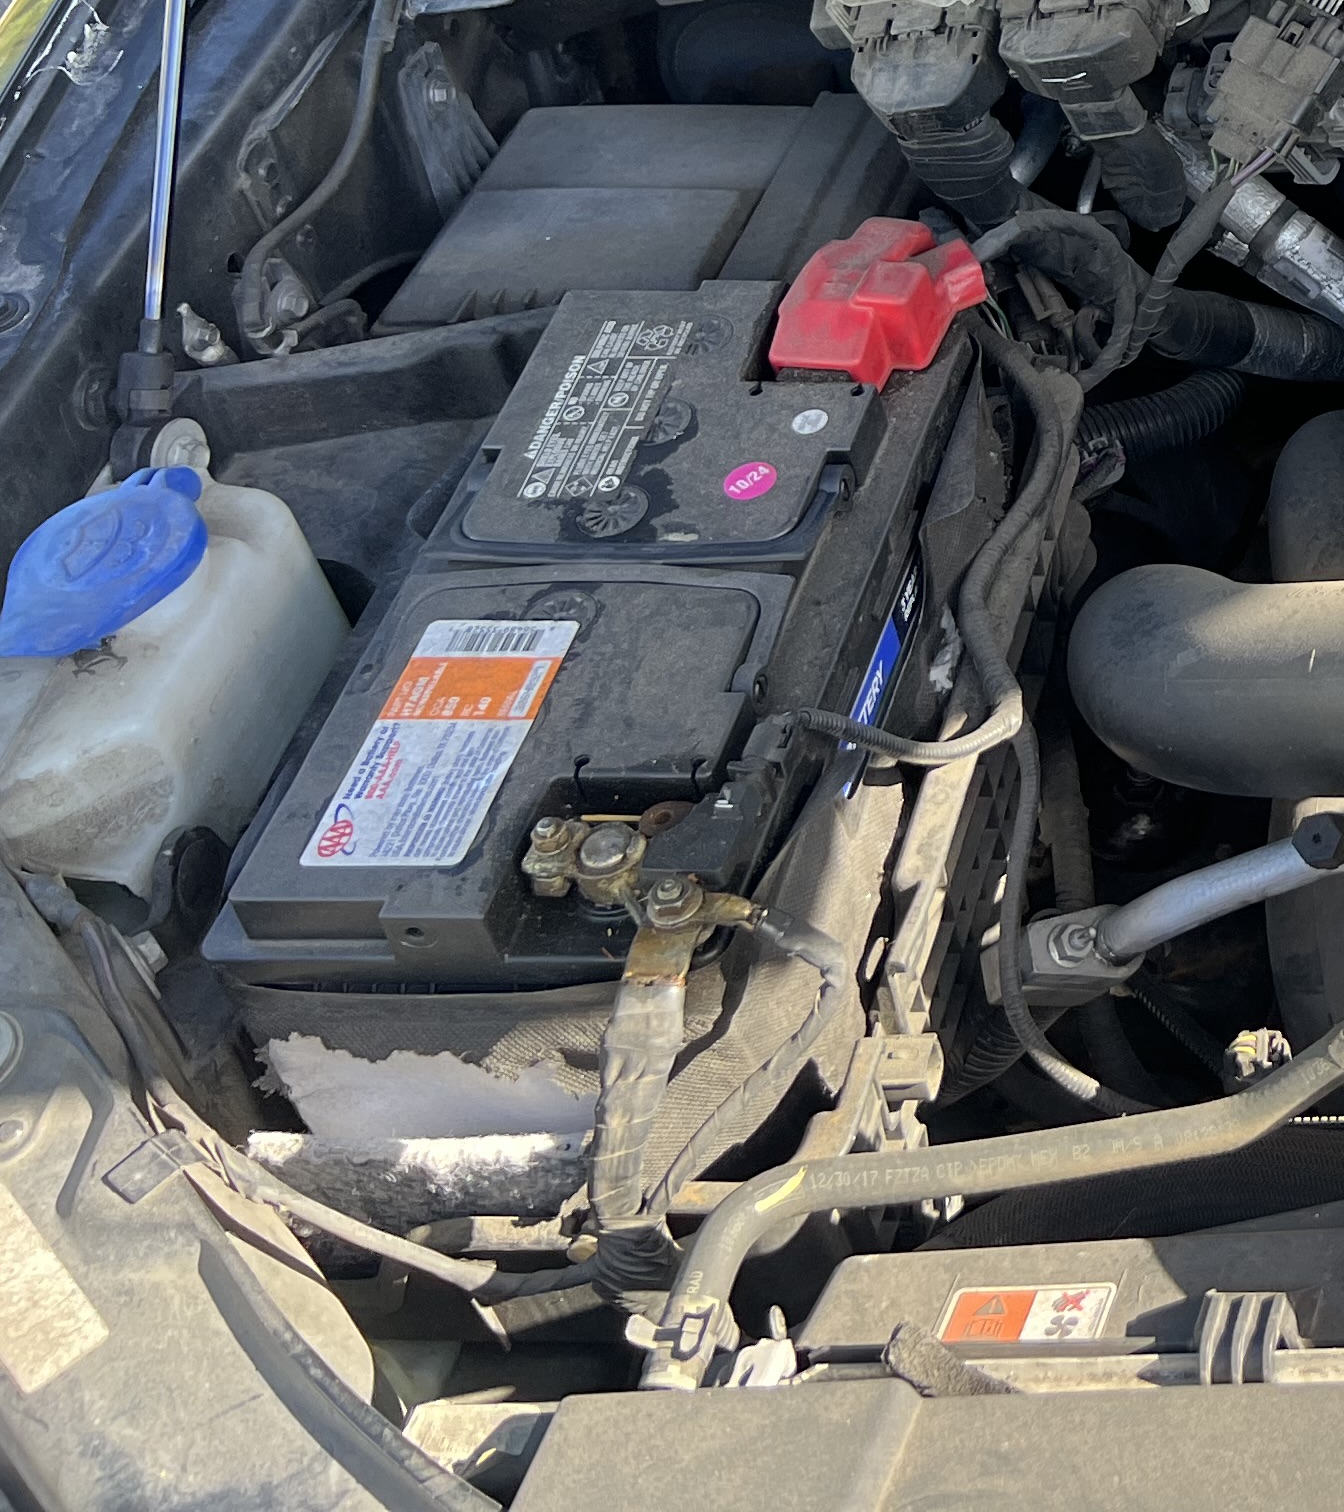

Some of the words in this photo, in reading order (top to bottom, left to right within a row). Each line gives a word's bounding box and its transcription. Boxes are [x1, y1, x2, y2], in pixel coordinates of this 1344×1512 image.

[530, 354, 586, 450] DANGER/POISON
[728, 465, 771, 497] 10/24
[471, 696, 493, 715] 140
[341, 776, 362, 799] Need
[360, 737, 384, 765] Battery
[353, 762, 385, 799] Warranty
[374, 759, 404, 799] AAA.com
[317, 819, 354, 857] AAA
[810, 1170, 879, 1190] 12/30/17
[1031, 1147, 1058, 1166] MEX
[1072, 1143, 1091, 1161] B2
[685, 1270, 704, 1293] RAD
